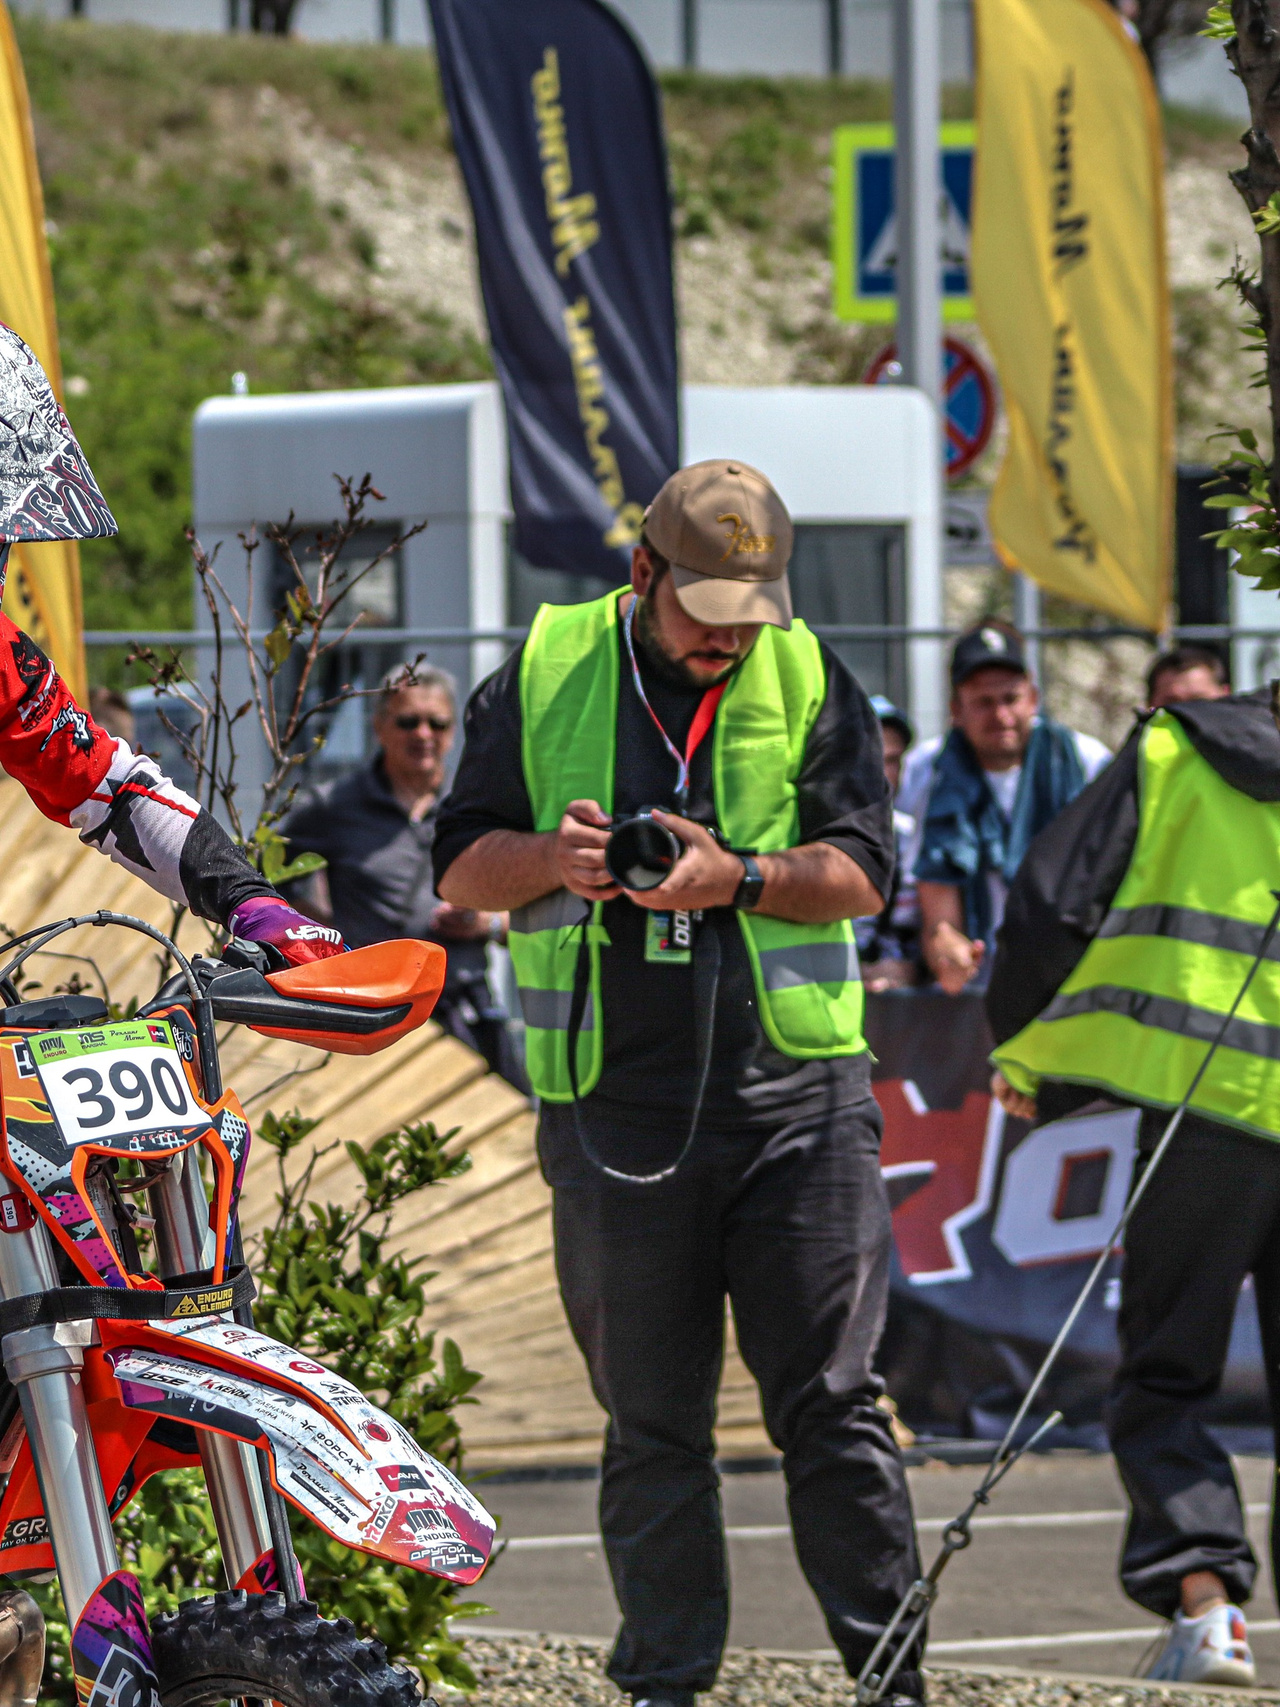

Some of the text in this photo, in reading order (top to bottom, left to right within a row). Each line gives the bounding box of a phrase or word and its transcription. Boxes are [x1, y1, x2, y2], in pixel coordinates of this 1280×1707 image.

[43, 1049, 67, 1059] ENDURO
[62, 1057, 188, 1128] 390
[4, 1203, 13, 1221] 390
[198, 1288, 233, 1304] ENDURO
[200, 1299, 233, 1312] ELEMENT
[215, 1382, 251, 1399] KENDA
[316, 1431, 365, 1475] ФОРСАЖ
[388, 1471, 421, 1481] LAVR
[365, 1496, 397, 1541] ROKO
[416, 1530, 461, 1543] ENDURO
[410, 1543, 466, 1561] ДРУГОЙ
[431, 1553, 485, 1568] ПУТЬ
